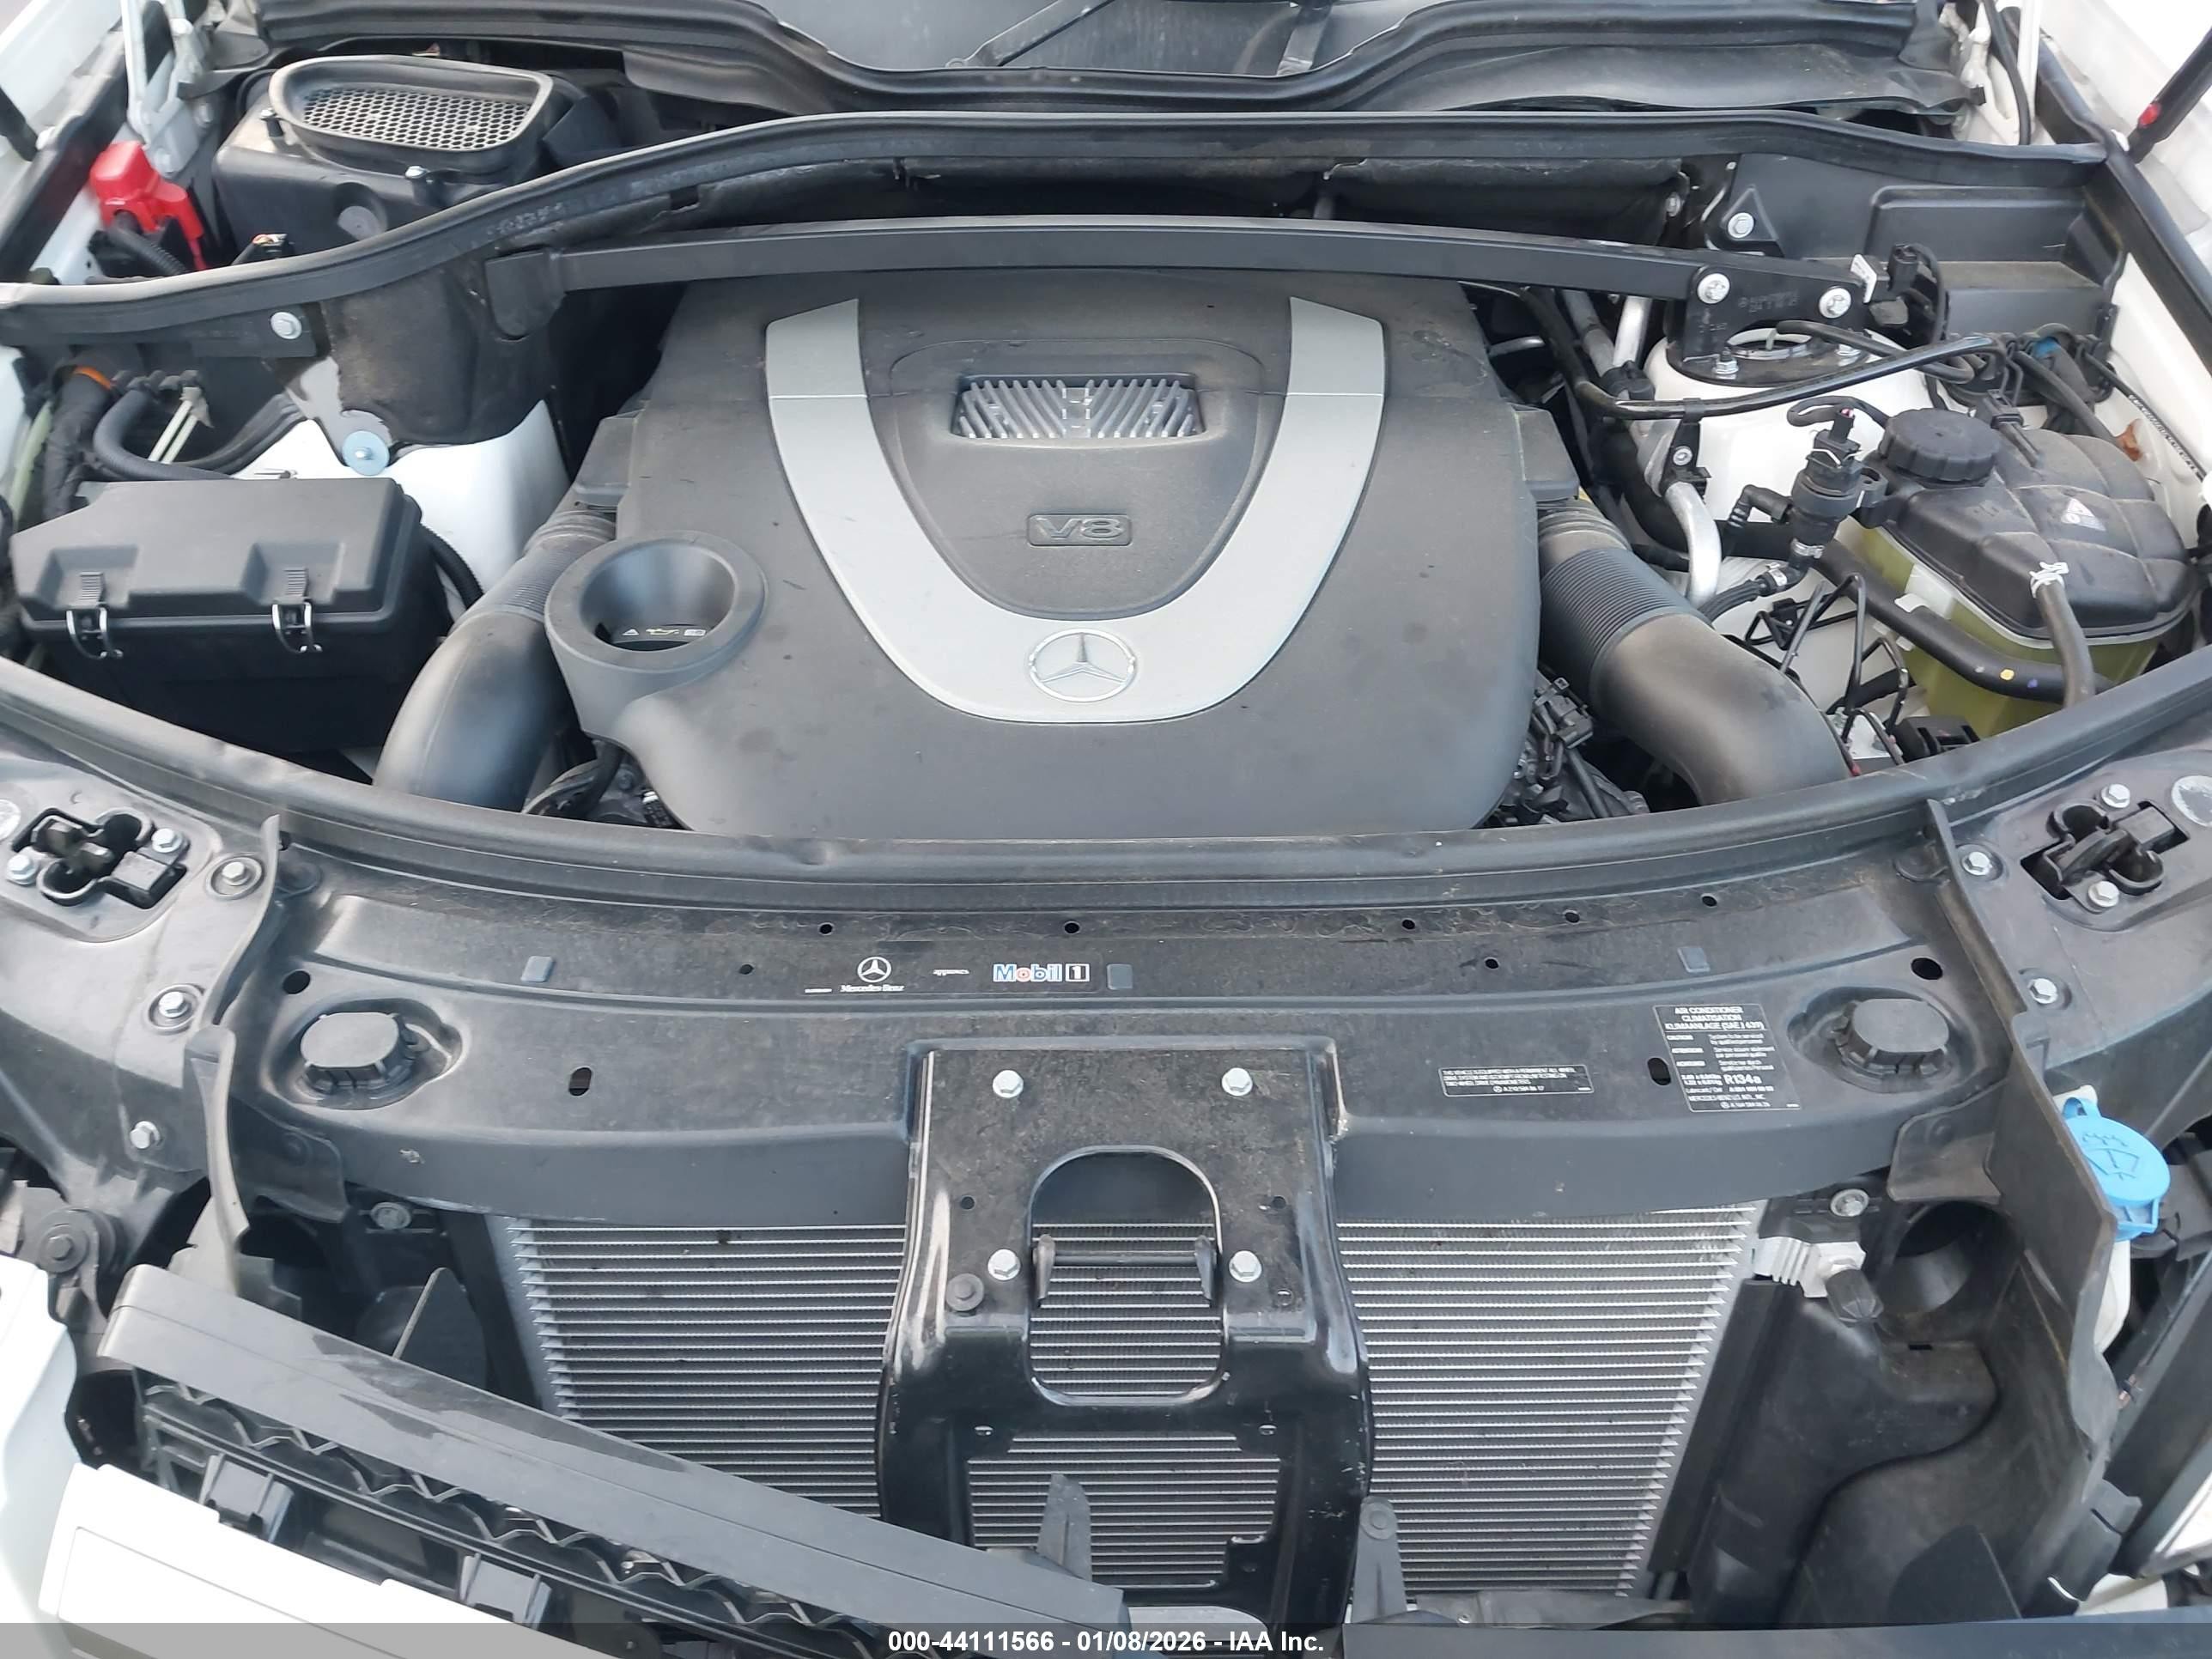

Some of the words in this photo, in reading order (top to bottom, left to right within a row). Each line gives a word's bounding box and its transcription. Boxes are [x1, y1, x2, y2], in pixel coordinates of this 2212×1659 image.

[1035, 518, 1125, 541] V8
[993, 963, 1062, 982] Mobil
[1723, 1073, 1762, 1085] R134a
